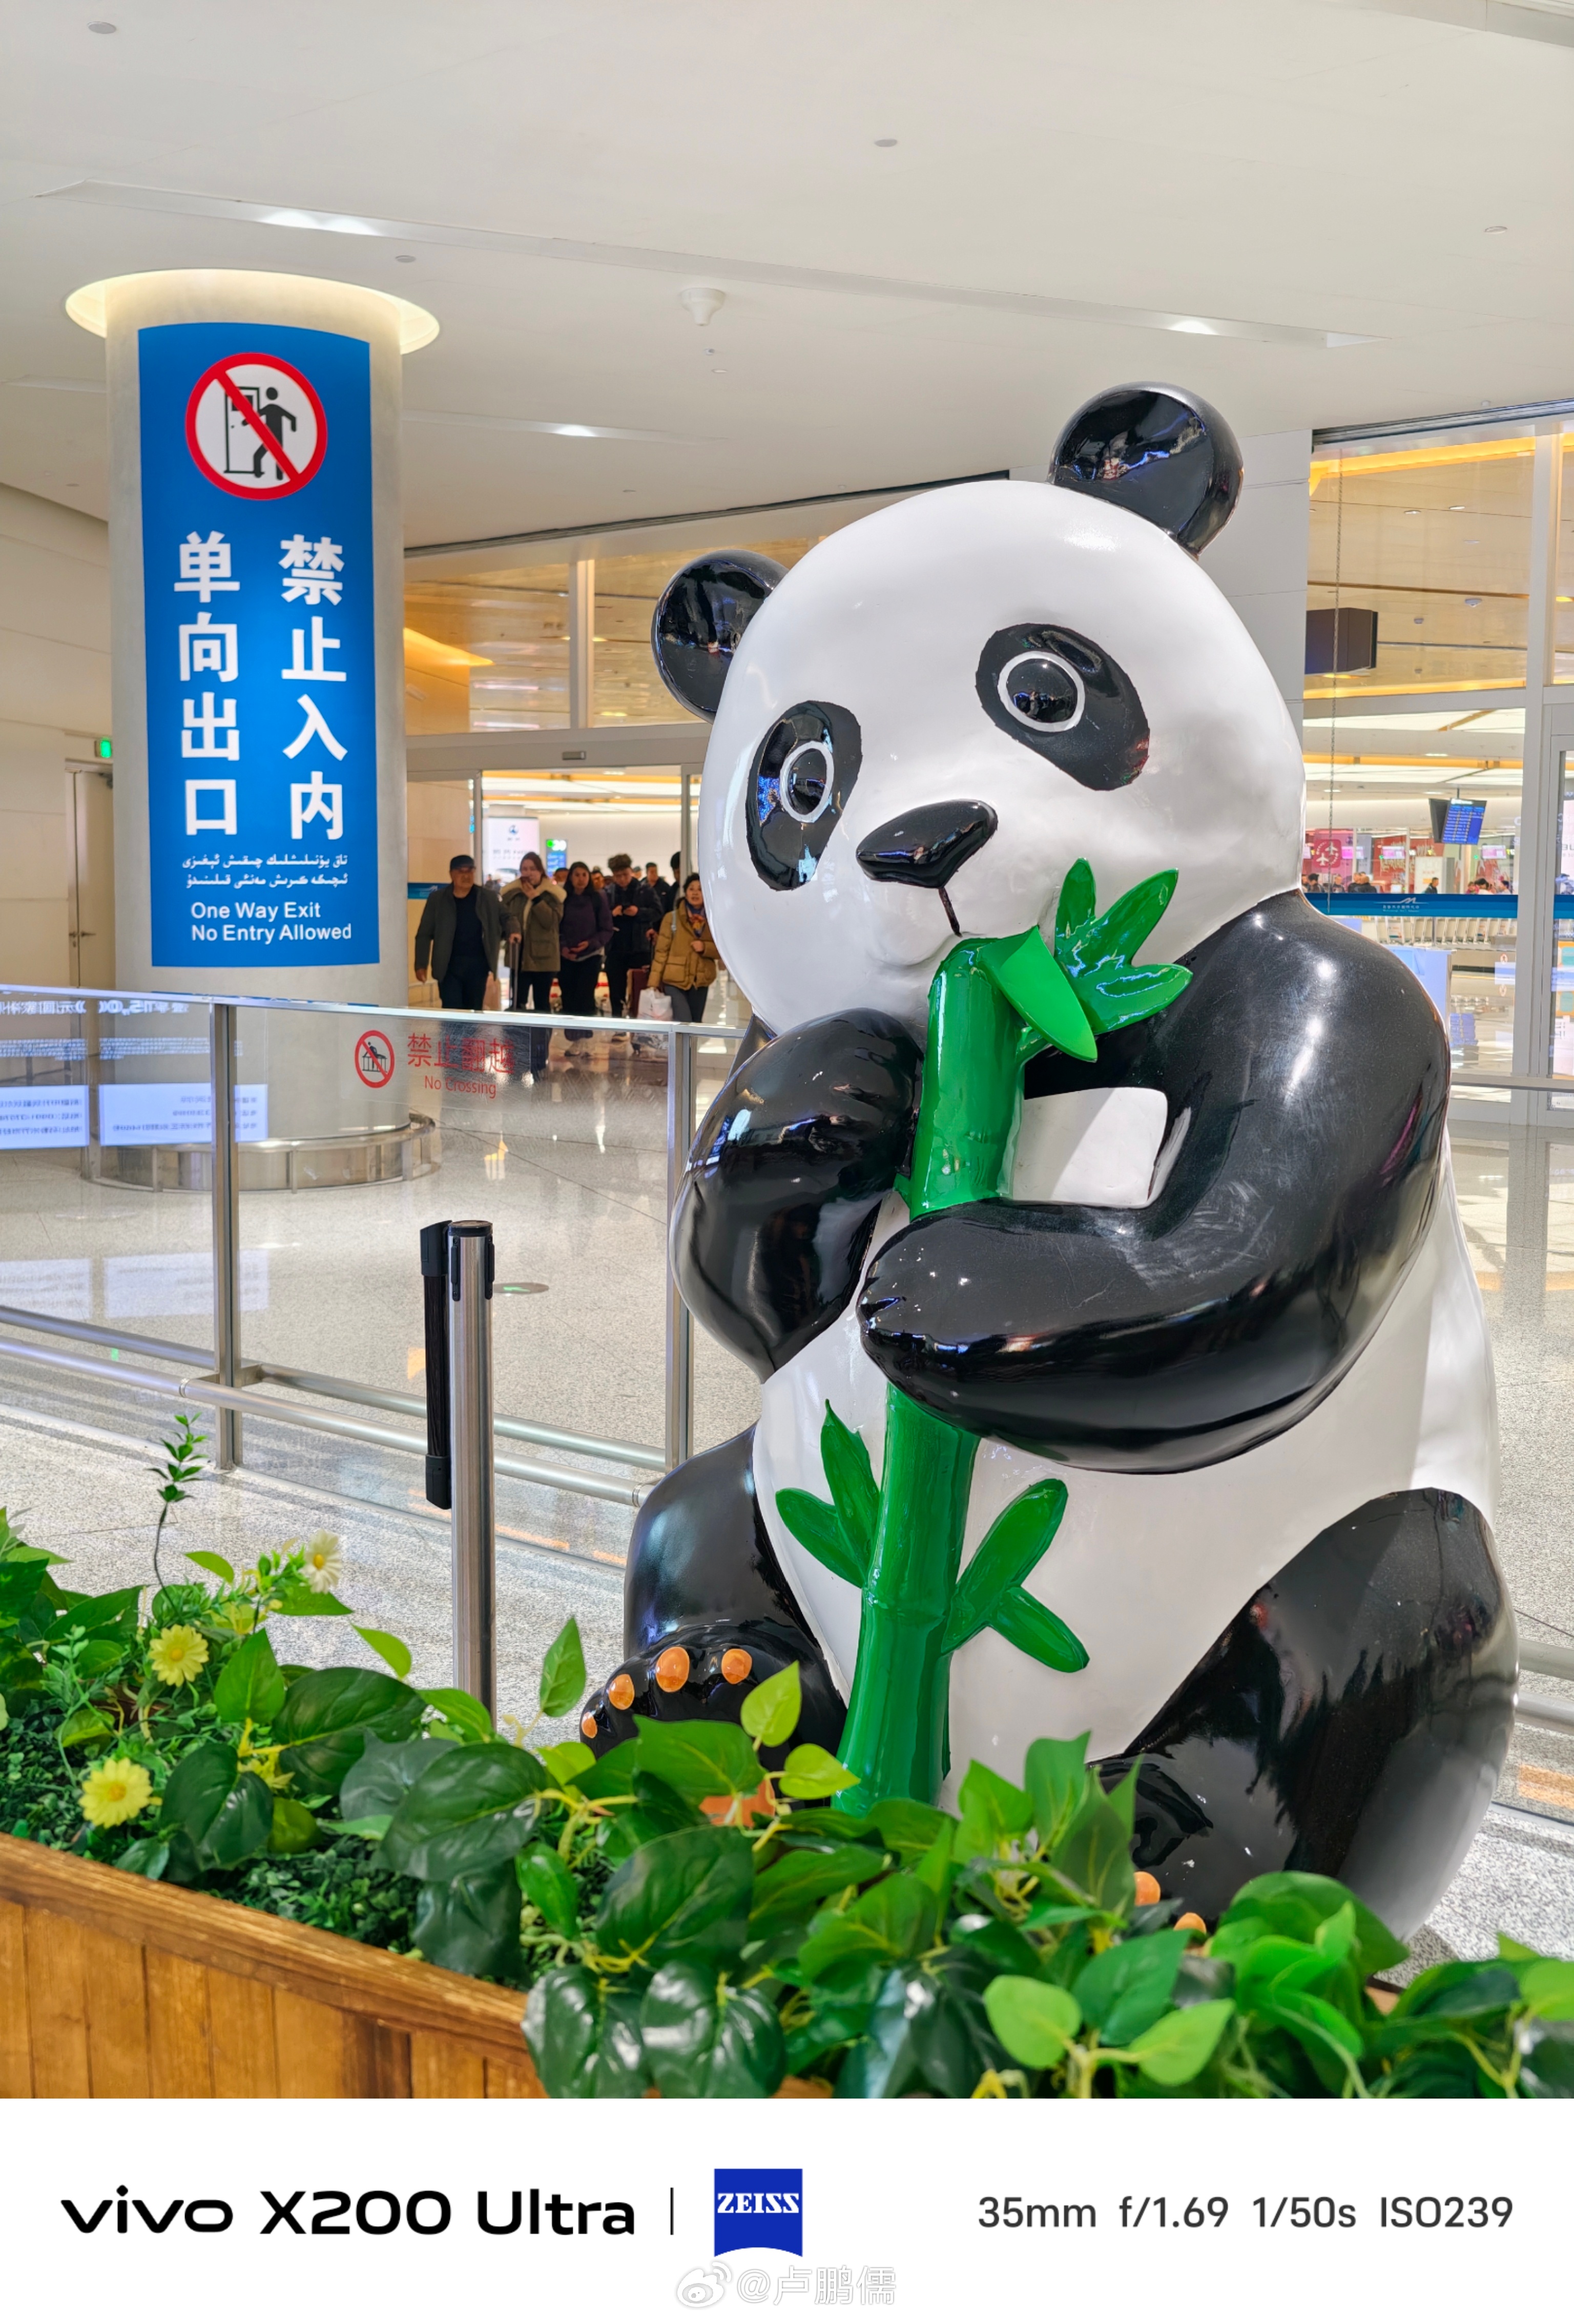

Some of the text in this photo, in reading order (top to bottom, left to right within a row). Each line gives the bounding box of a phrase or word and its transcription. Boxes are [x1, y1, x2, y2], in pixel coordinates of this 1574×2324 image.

[174, 531, 240, 836] 单向出口
[279, 534, 348, 840] 禁止入内
[191, 902, 321, 922] One Way Exit
[192, 924, 351, 945] No Entry Allowed
[407, 1032, 514, 1073] 禁止翻越
[424, 1075, 496, 1098] No Crossing
